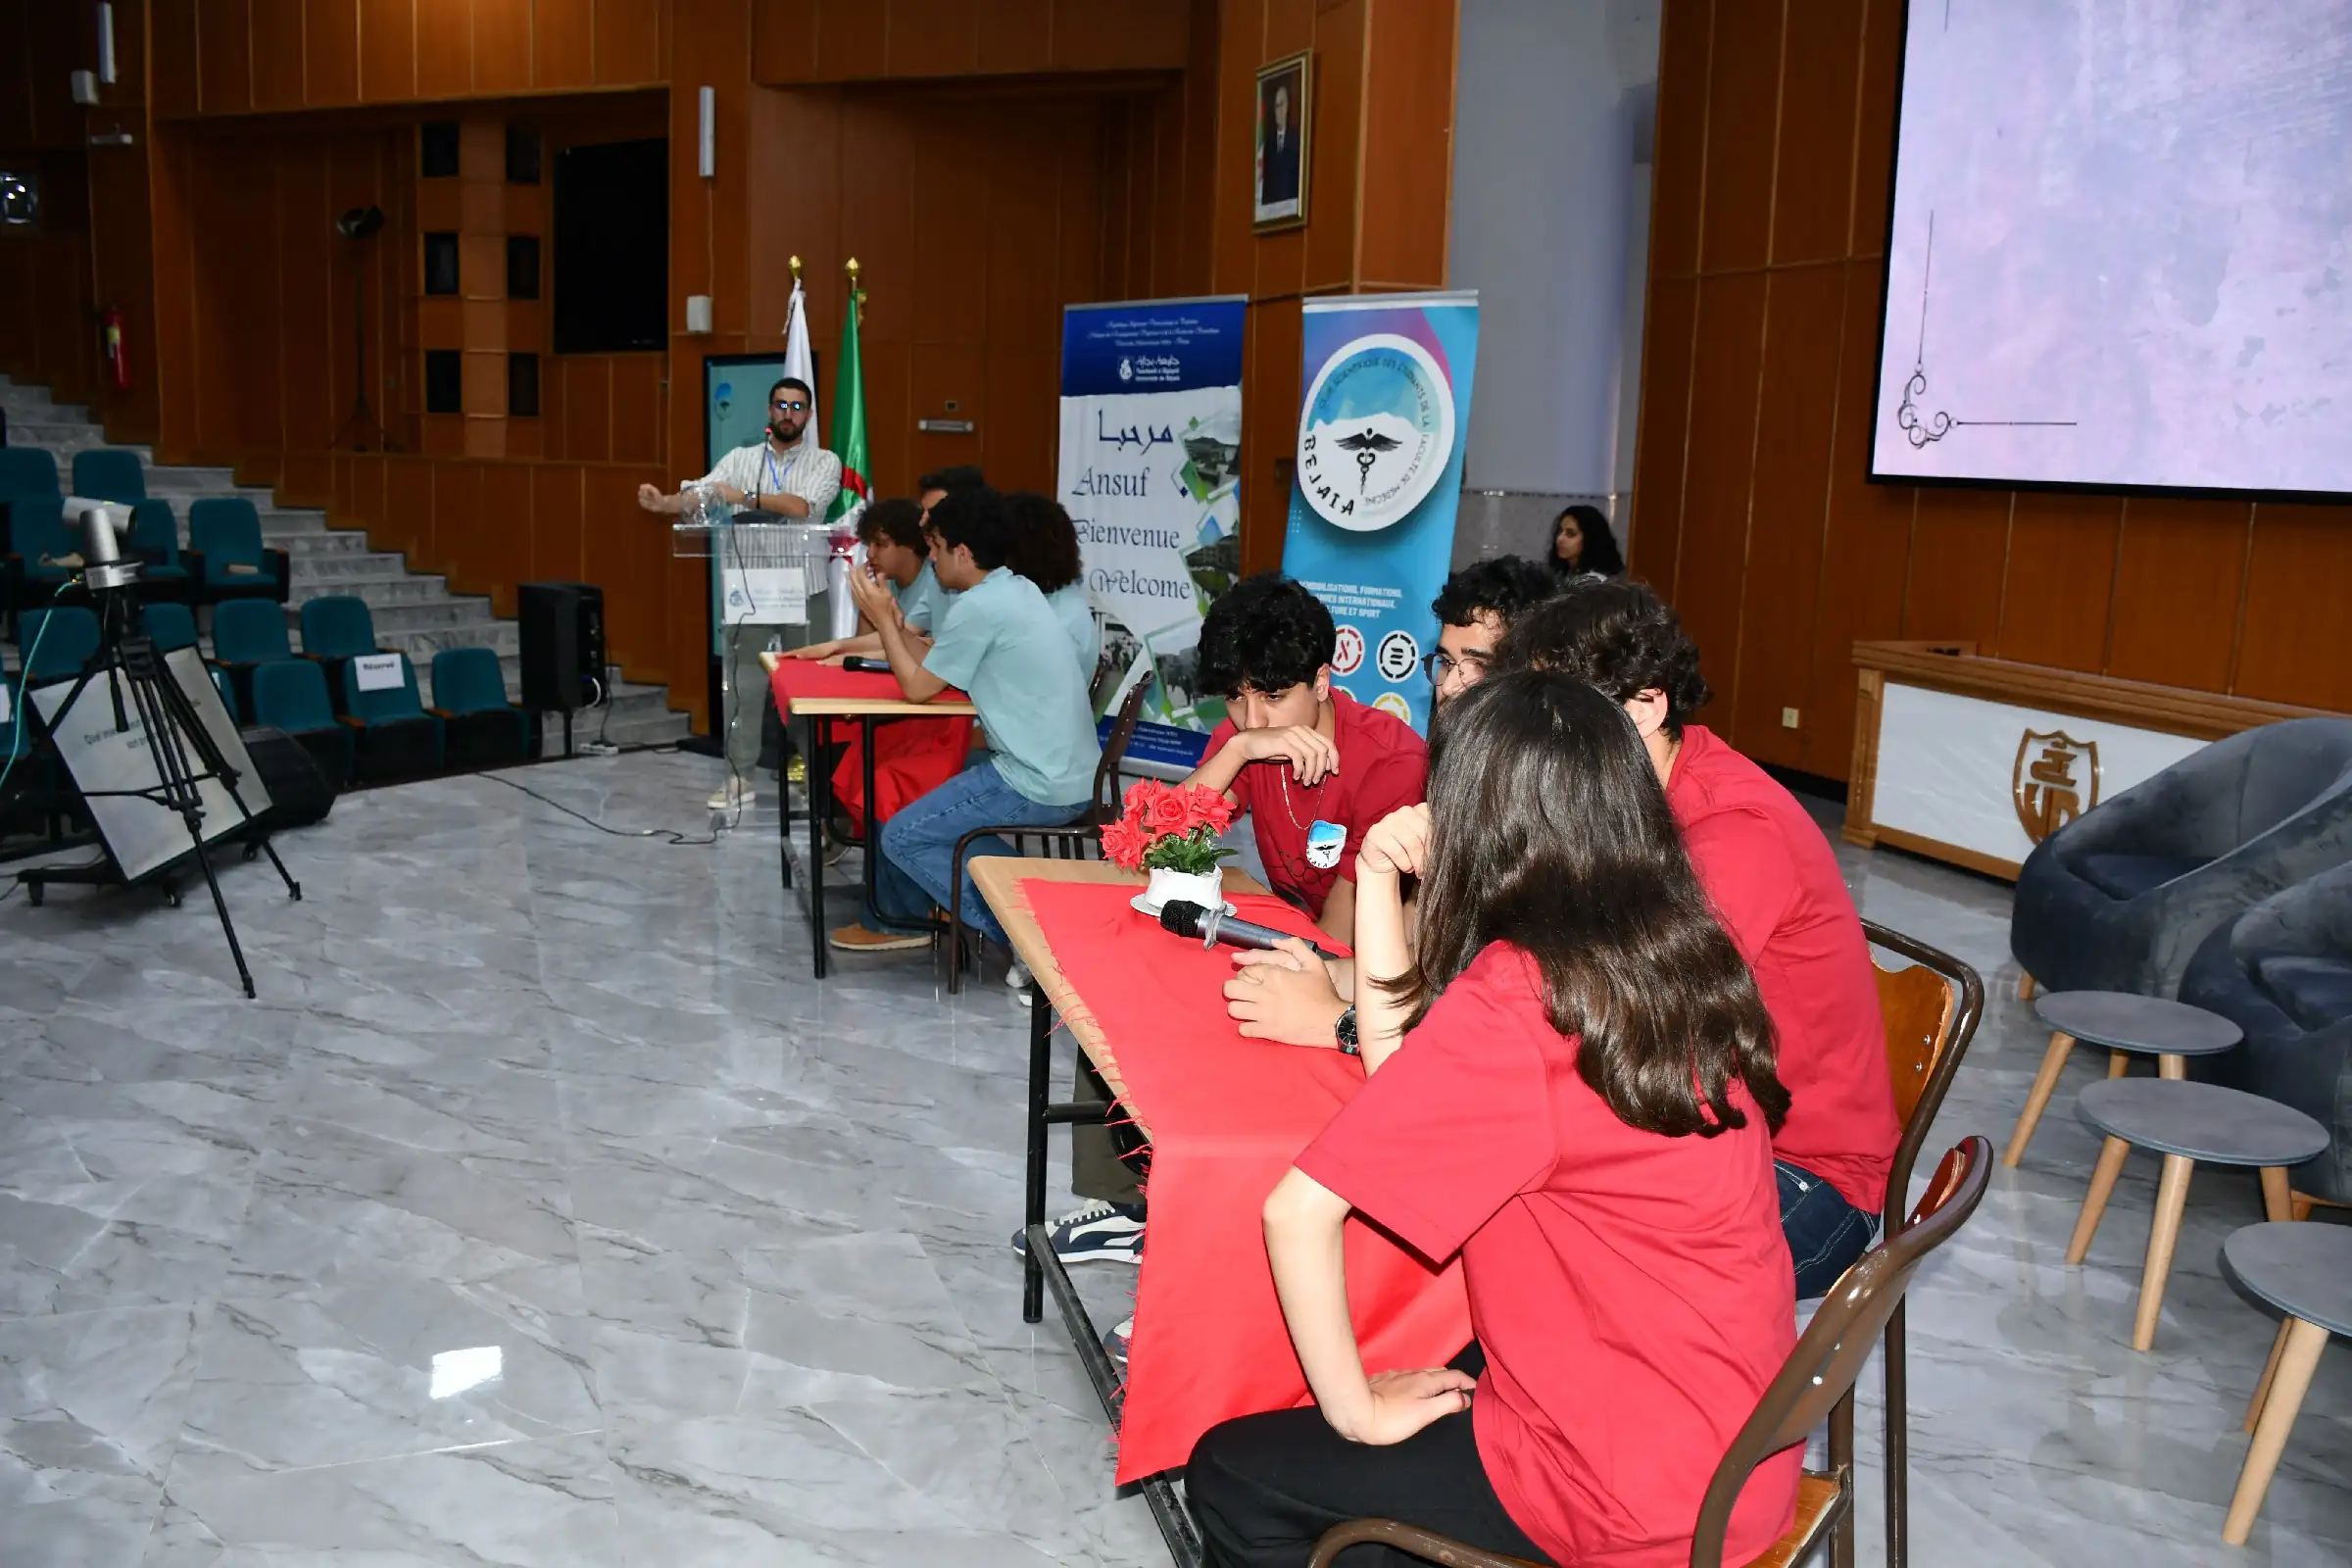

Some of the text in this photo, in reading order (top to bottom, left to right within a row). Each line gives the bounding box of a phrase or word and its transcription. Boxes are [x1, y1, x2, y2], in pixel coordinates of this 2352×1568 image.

[1098, 408, 1174, 457] مرحبا
[1071, 466, 1151, 498] Ansuf
[1304, 434, 1354, 515] BEJAIA
[1071, 517, 1180, 549] Bienvenue
[1089, 567, 1191, 600] Welcome
